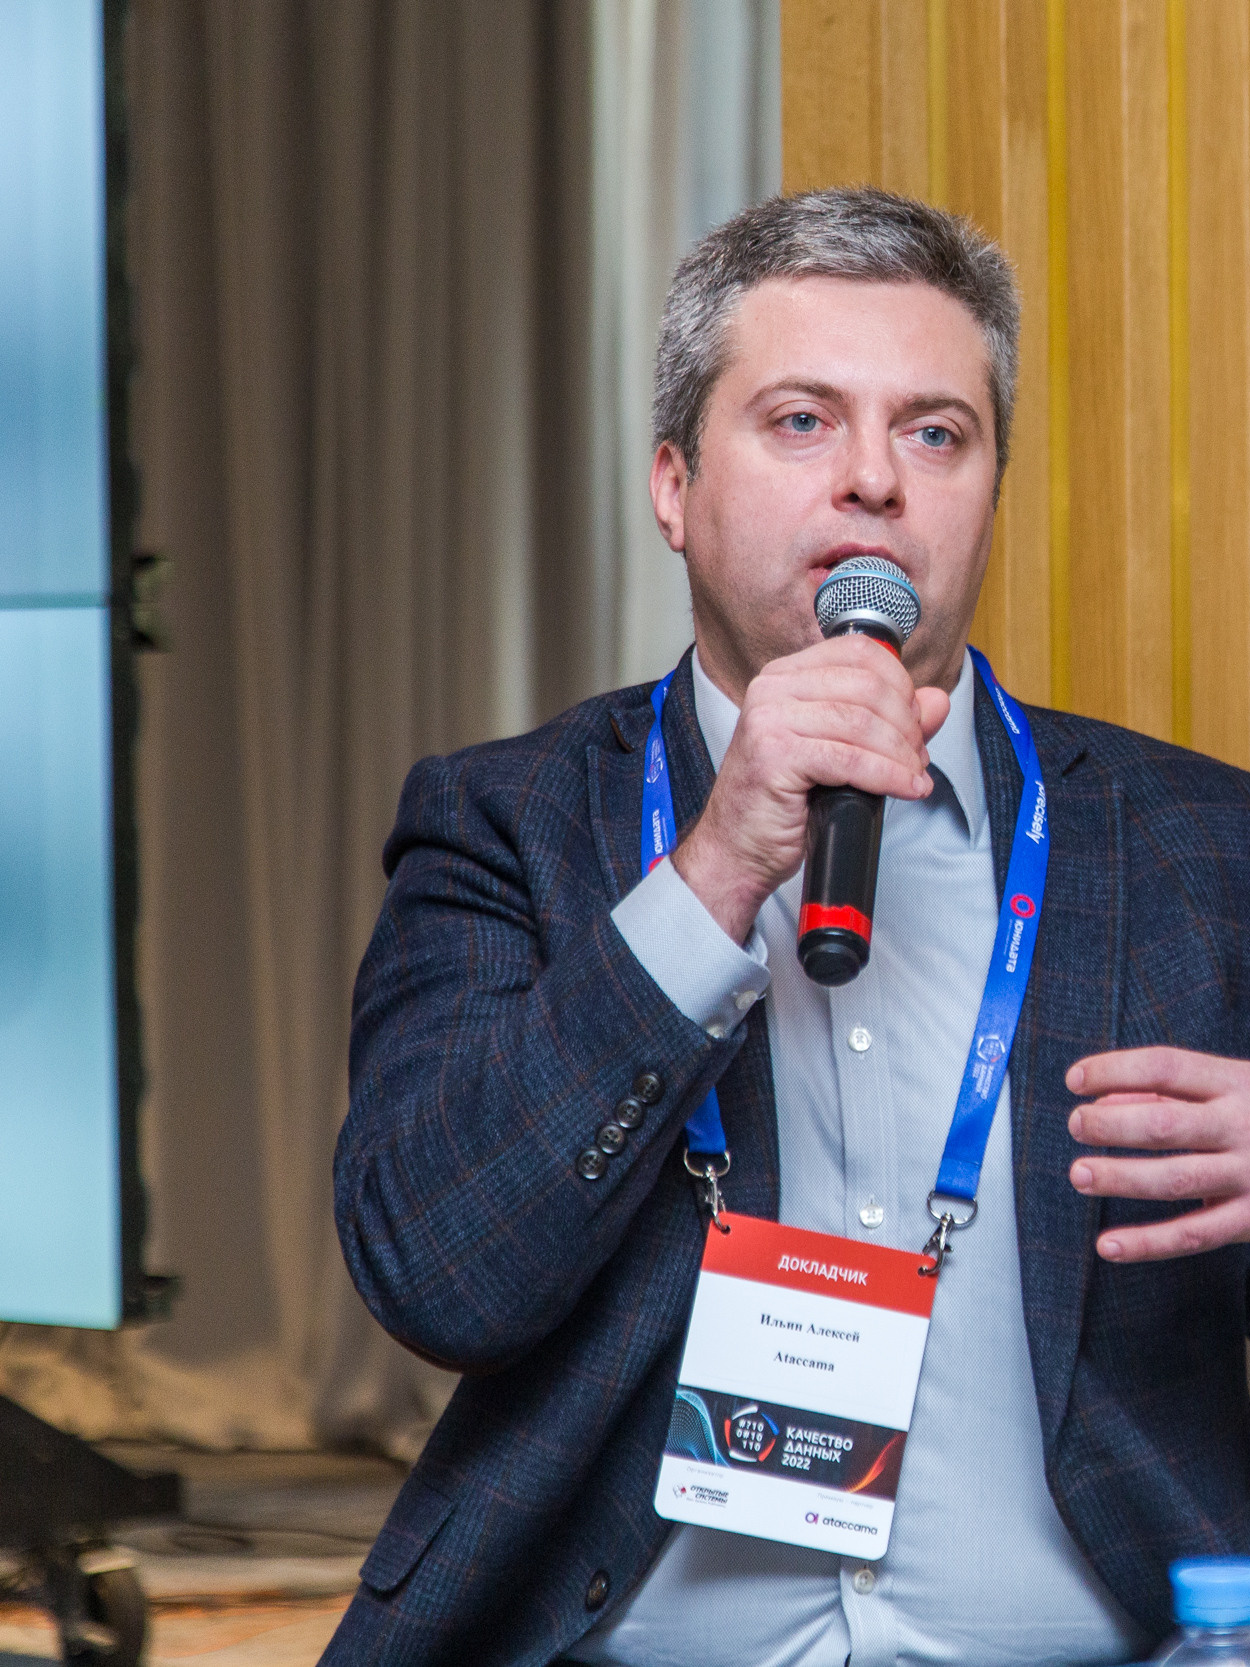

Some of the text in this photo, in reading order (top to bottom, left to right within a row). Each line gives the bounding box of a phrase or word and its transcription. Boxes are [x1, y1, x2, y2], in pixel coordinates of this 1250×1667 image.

[1025, 780, 1048, 845] precisely
[777, 1254, 869, 1287] ДОКЛАДЧИК
[760, 1312, 861, 1343] Ильин Алексей
[773, 1350, 835, 1373] Ataccama
[785, 1426, 854, 1452] КАЧЕСТВО
[781, 1454, 812, 1471] 2022
[783, 1440, 842, 1463] ДАННЫХ
[822, 1516, 878, 1536] ataccama
